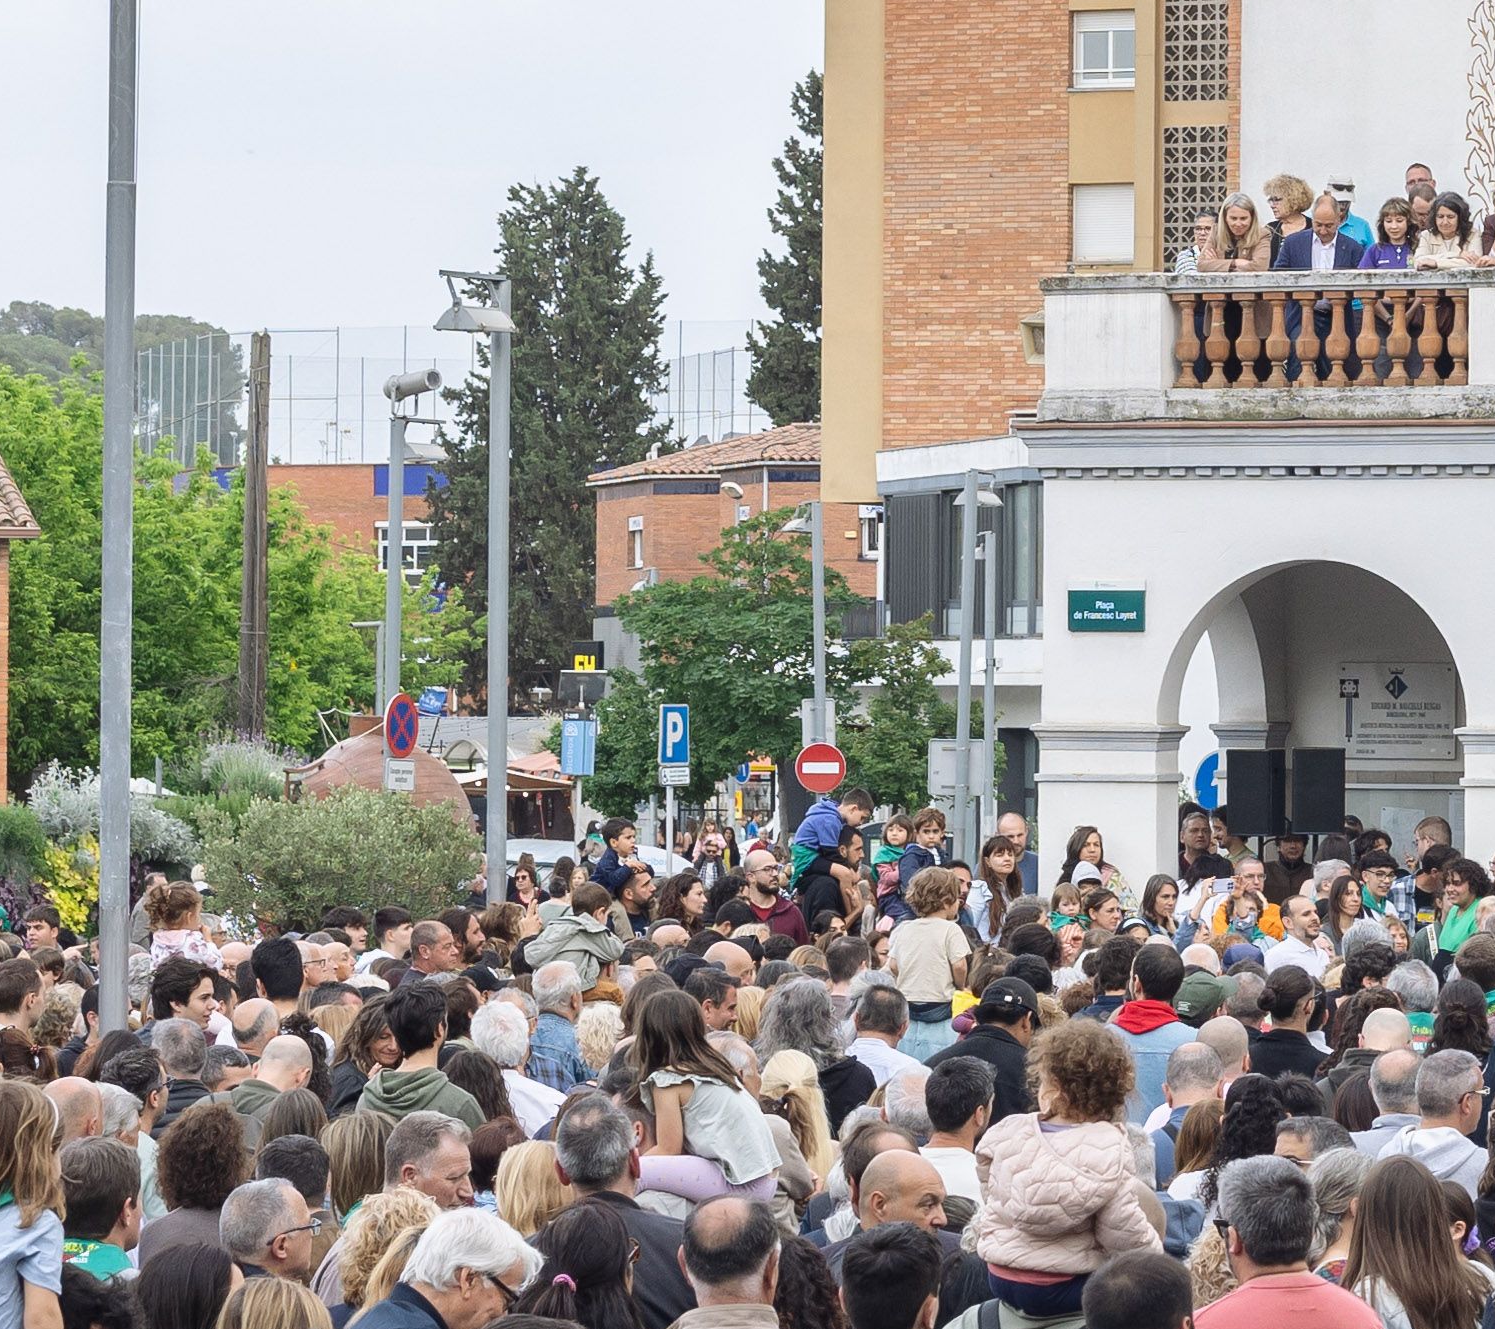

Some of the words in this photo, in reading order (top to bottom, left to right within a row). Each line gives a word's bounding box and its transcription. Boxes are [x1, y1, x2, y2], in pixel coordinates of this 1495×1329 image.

[1095, 600, 1114, 612] Plaça
[1073, 611, 1083, 619] de
[1084, 611, 1114, 619] Francesc
[666, 711, 684, 758] P
